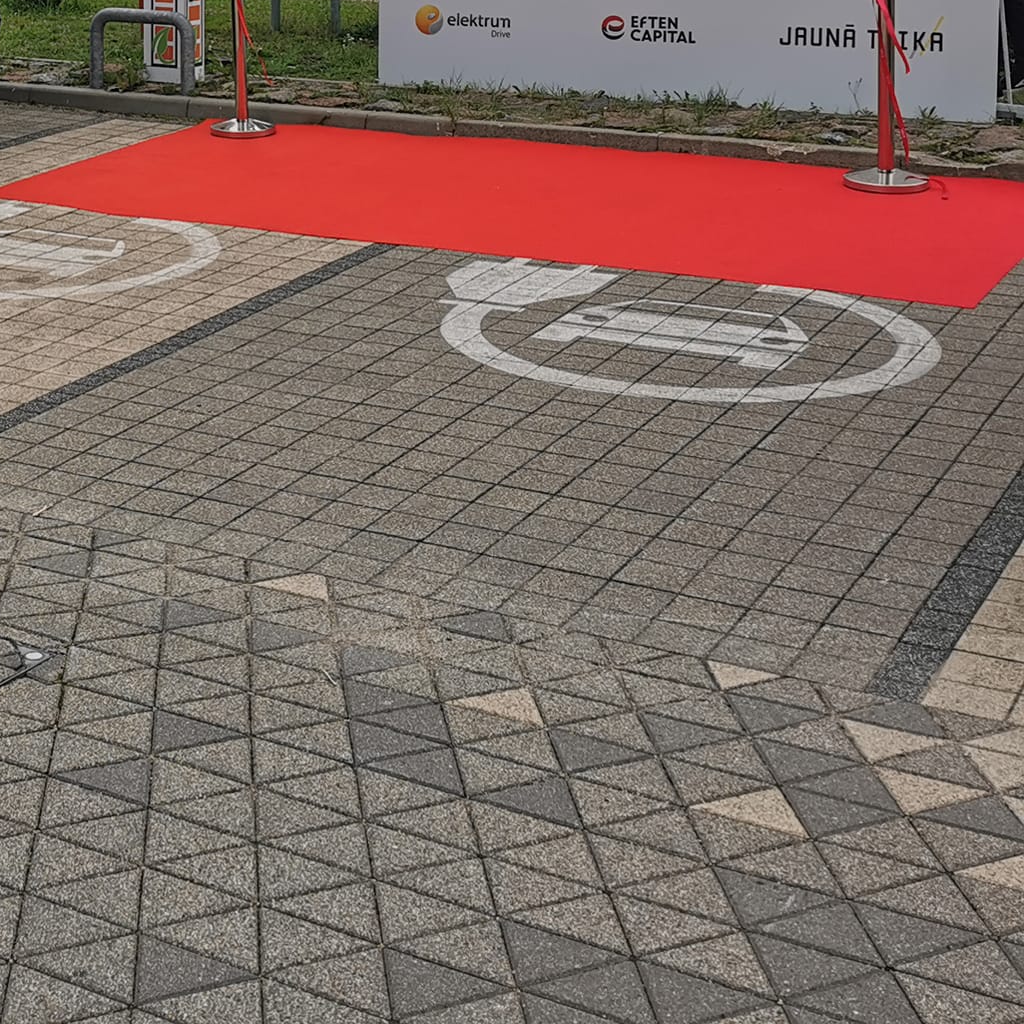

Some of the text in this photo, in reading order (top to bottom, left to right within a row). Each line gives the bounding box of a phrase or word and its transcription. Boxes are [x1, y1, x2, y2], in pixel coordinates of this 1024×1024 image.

[447, 13, 511, 28] elektrum
[491, 29, 511, 38] Drive
[630, 29, 696, 43] CAPITAL
[779, 24, 943, 52] JAUNĀ TIKA
